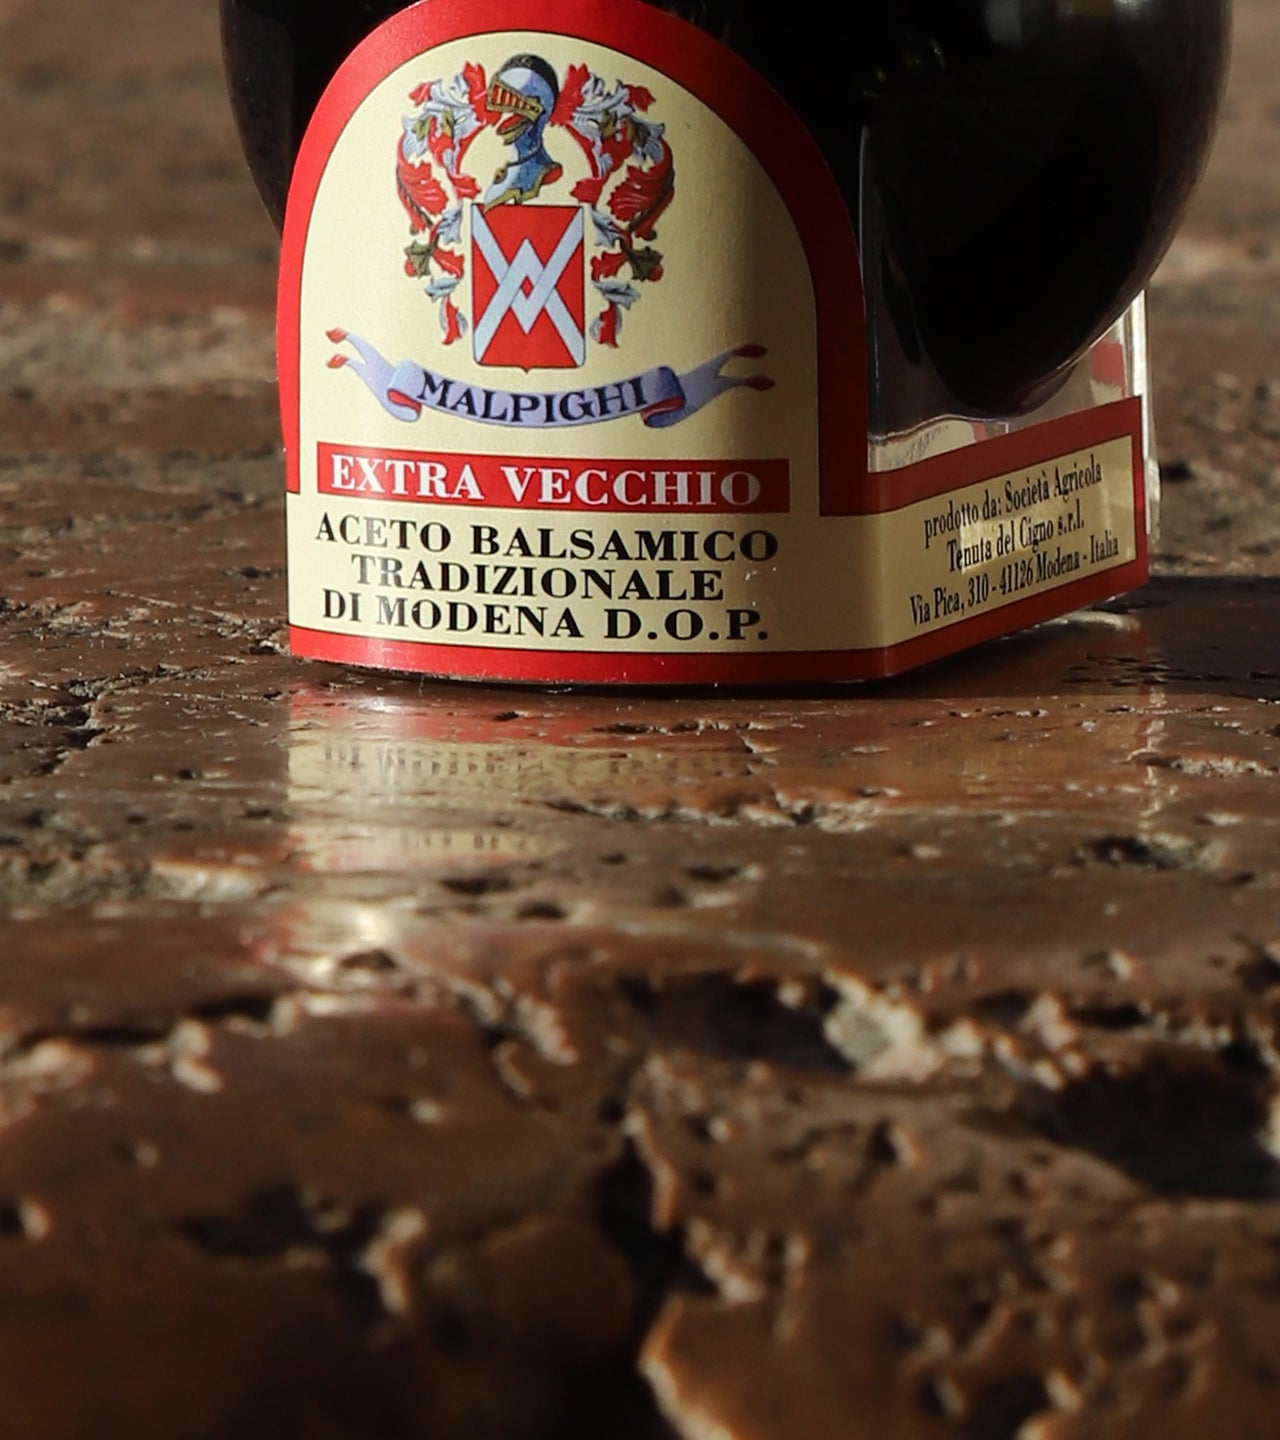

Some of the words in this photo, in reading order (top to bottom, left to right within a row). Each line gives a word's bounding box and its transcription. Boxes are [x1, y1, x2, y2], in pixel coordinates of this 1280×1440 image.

[416, 371, 646, 423] MALPIGHI
[330, 453, 485, 500] EXTRA
[501, 466, 761, 506] VECCHIO
[924, 501, 979, 549] prodotto
[982, 490, 1002, 518] da:
[1004, 471, 1050, 514] Società
[1053, 454, 1102, 502] Agricola
[315, 512, 451, 553] ACETO
[470, 525, 778, 562] BALSAMICO
[947, 538, 993, 573] Tenuta
[996, 522, 1015, 556] del
[1019, 516, 1054, 551] Cigno
[1057, 498, 1085, 534] s.r.l.
[351, 554, 724, 601] TRADIZIONALE
[910, 594, 931, 626] Via
[933, 583, 966, 619] Pica,
[967, 576, 989, 607] 310
[999, 558, 1034, 597] 41126
[1036, 547, 1081, 584] Modena
[1090, 534, 1119, 561] Italia
[322, 588, 361, 622] DI
[376, 594, 584, 639] MODENA
[603, 608, 769, 641] D.O.P.
